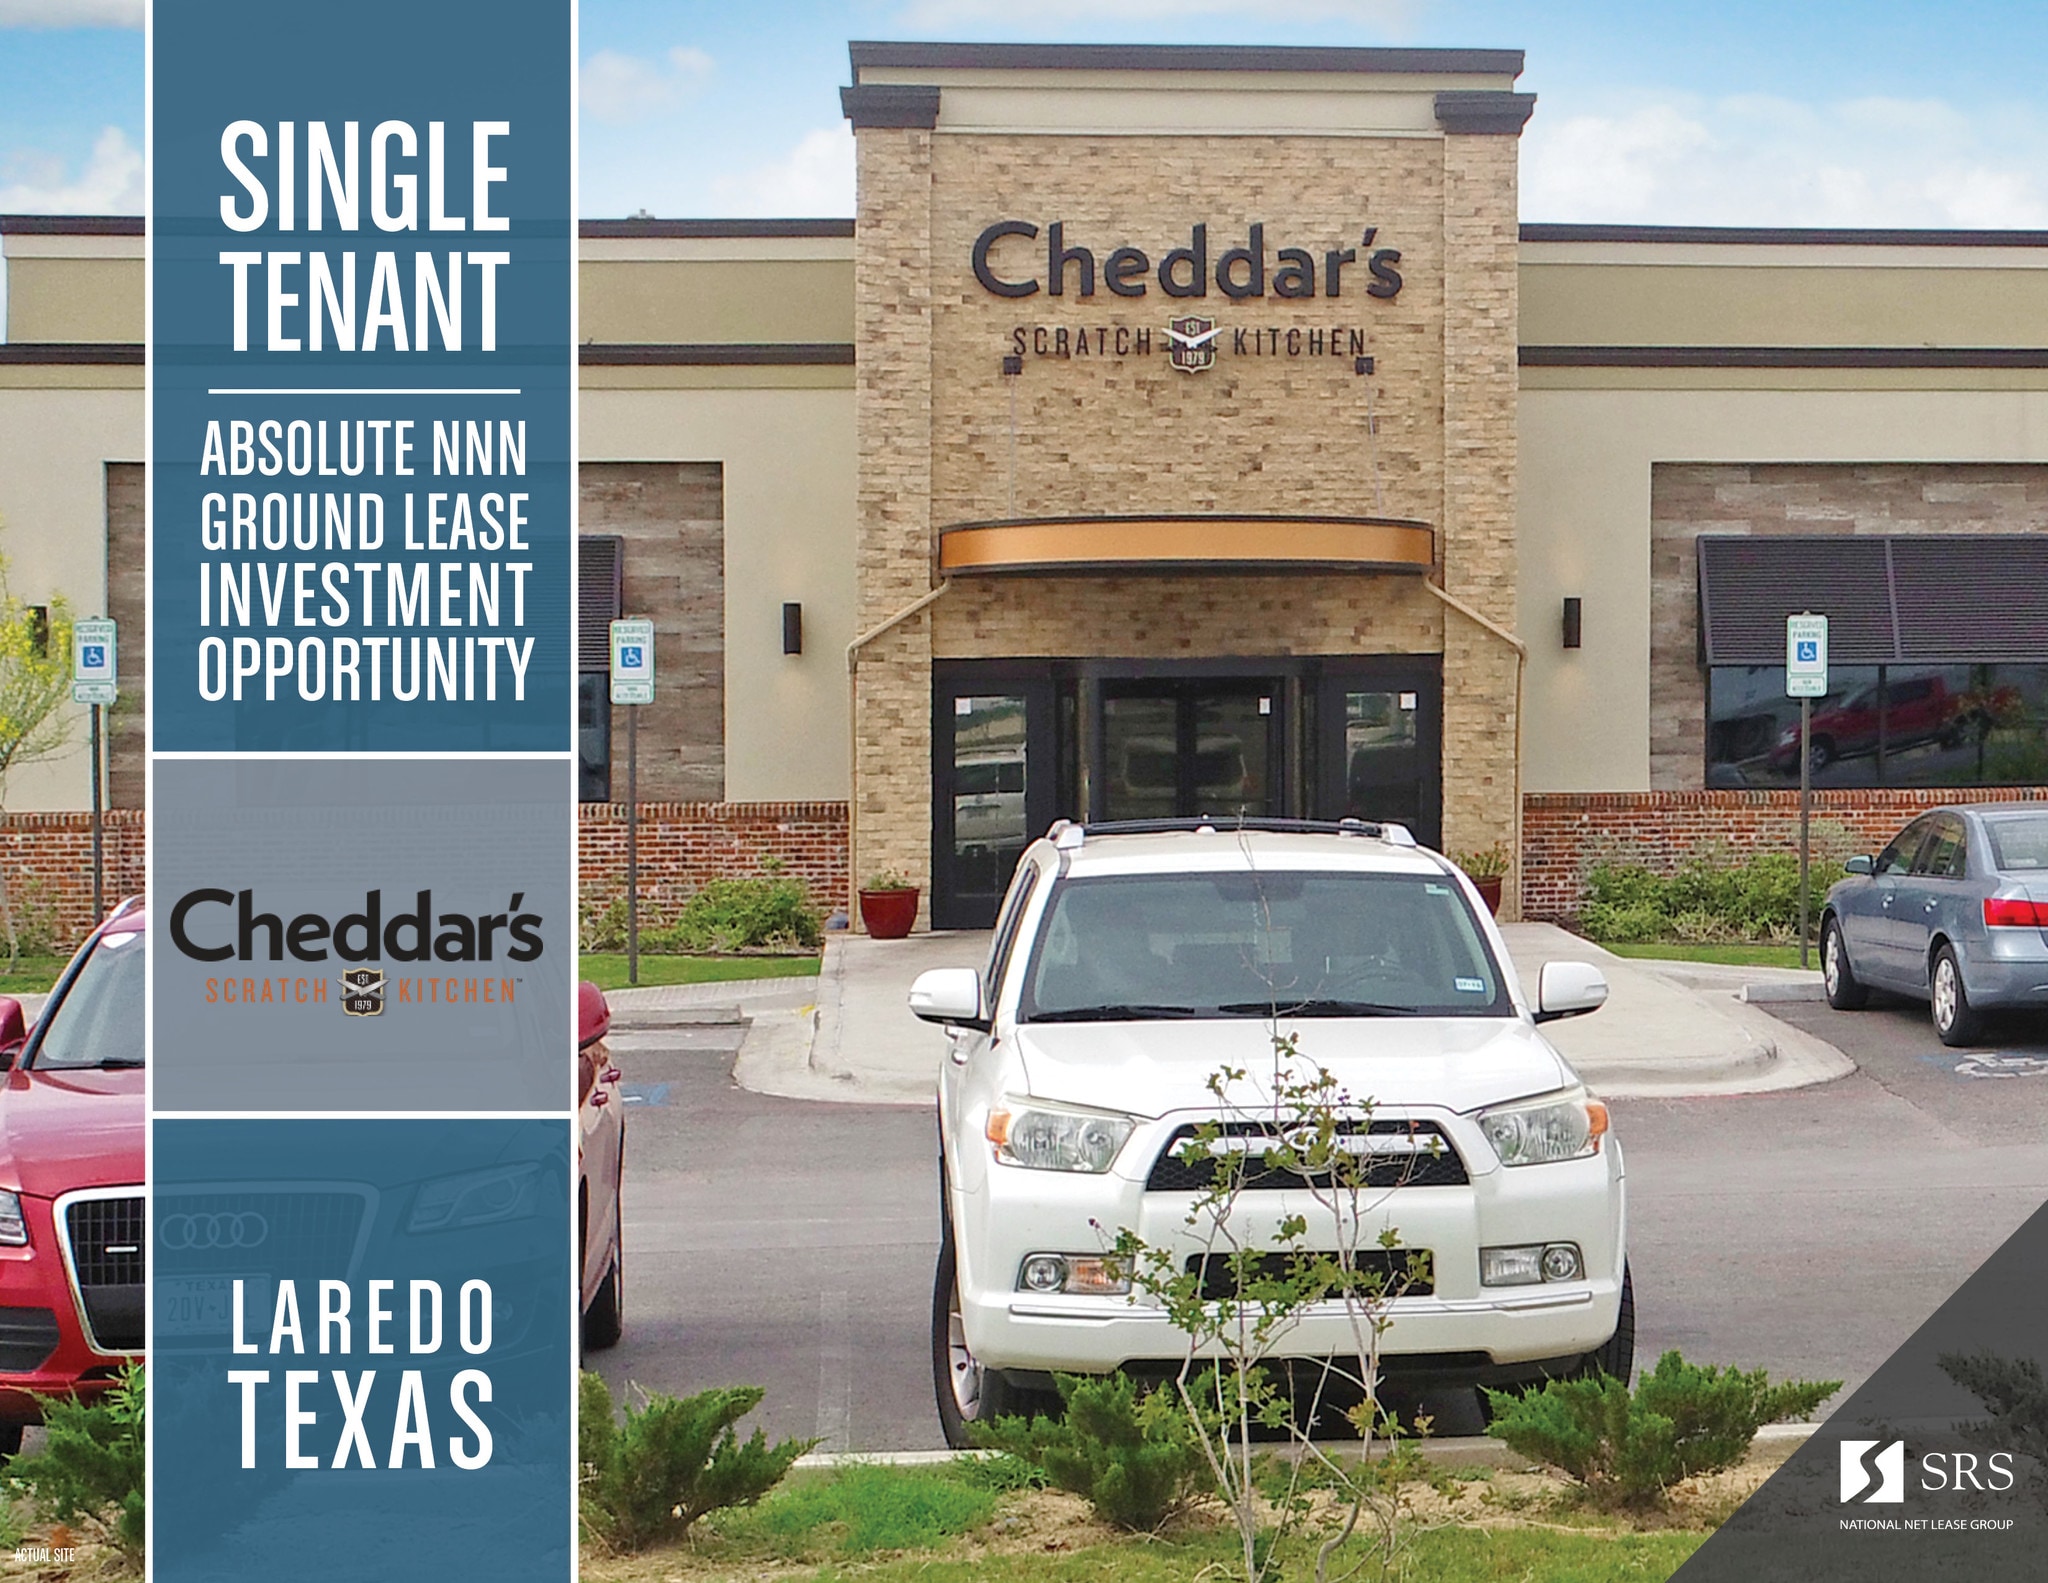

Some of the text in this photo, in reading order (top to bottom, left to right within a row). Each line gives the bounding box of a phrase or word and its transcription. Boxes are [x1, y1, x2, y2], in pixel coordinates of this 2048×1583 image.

[971, 220, 1403, 299] Cheddar's
[1012, 327, 1365, 357] SCRATCH KITCHEN
[1181, 351, 1205, 366] 1979
